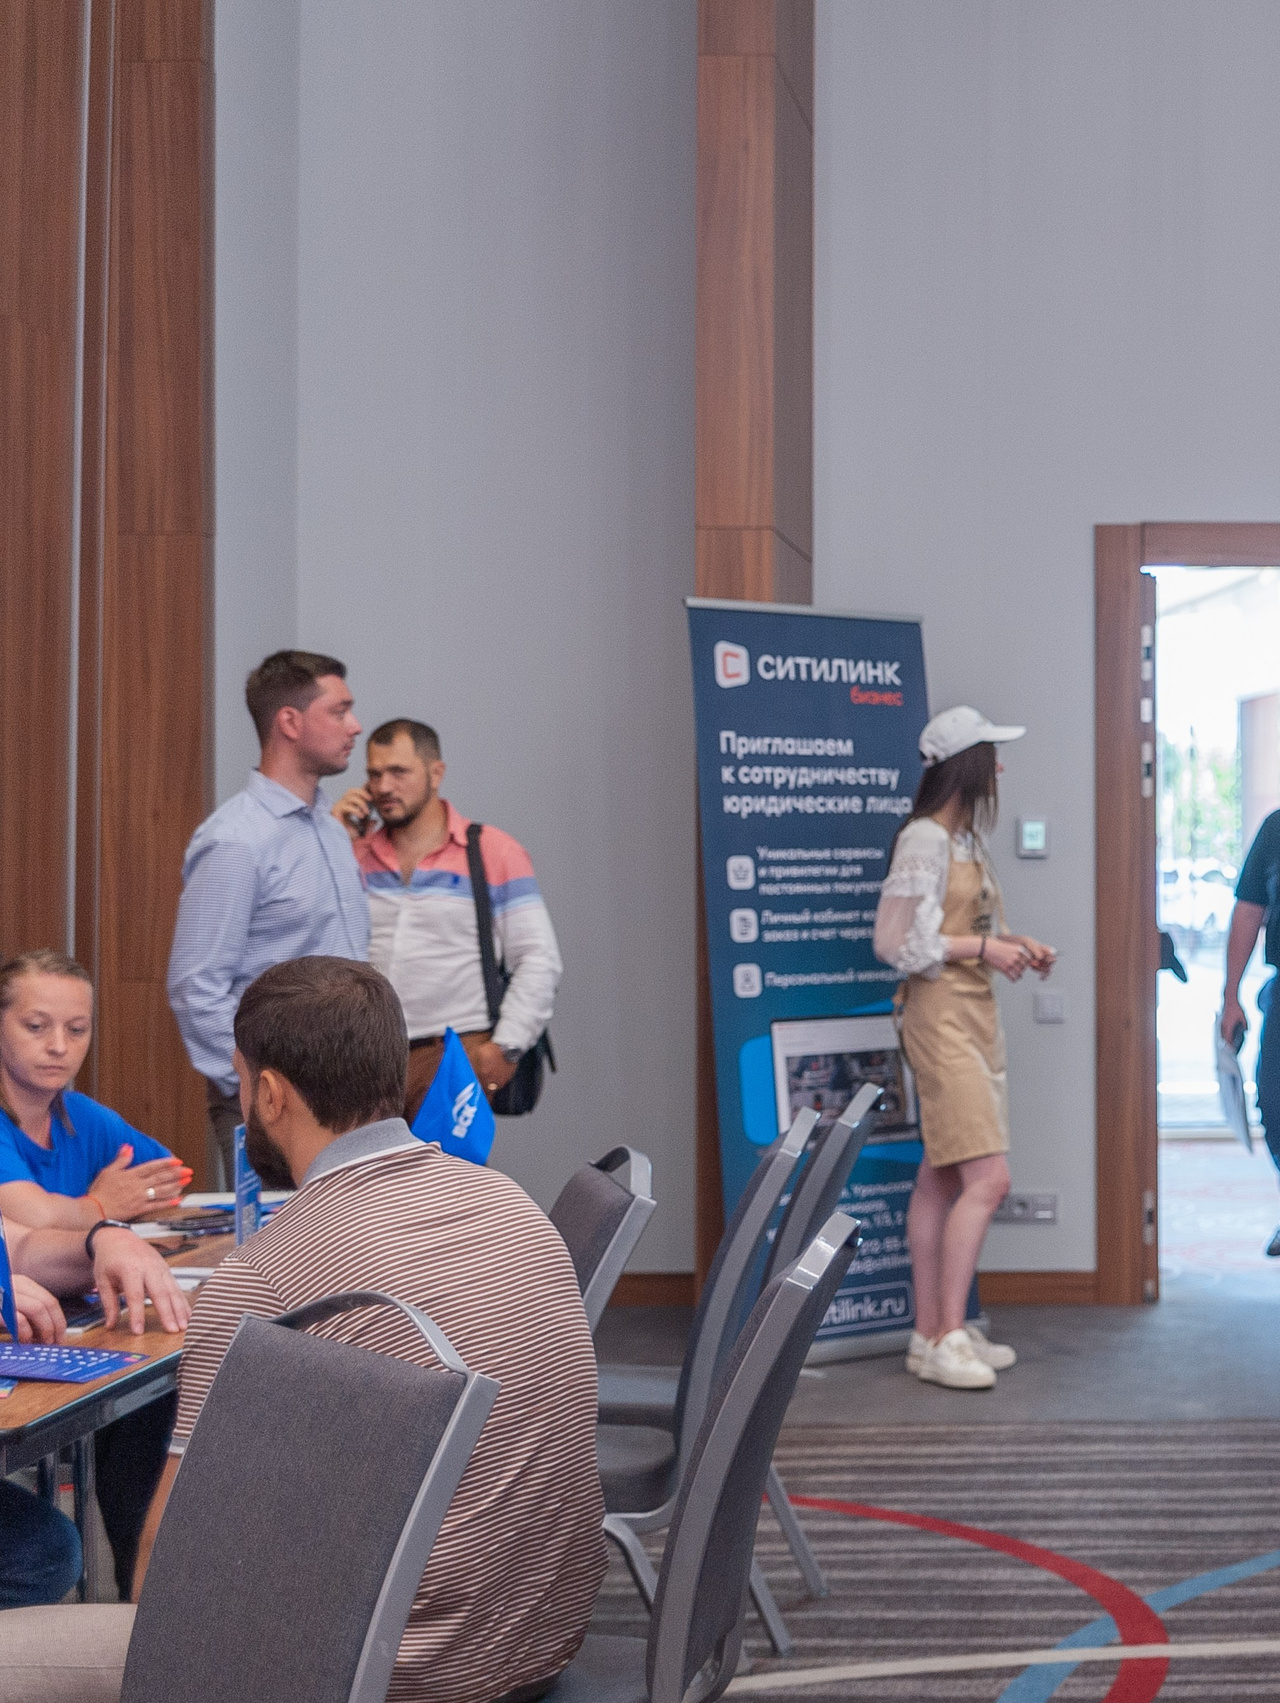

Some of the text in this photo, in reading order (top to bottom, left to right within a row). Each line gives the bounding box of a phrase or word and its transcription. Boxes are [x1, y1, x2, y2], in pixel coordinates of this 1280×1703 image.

[757, 655, 901, 686] СИТИЛИНК
[850, 686, 903, 706] бизнес
[720, 731, 854, 758] Приглашаем
[721, 767, 900, 790] к сотрудничеству
[723, 795, 862, 819] юридические
[813, 907, 860, 923] кабинет
